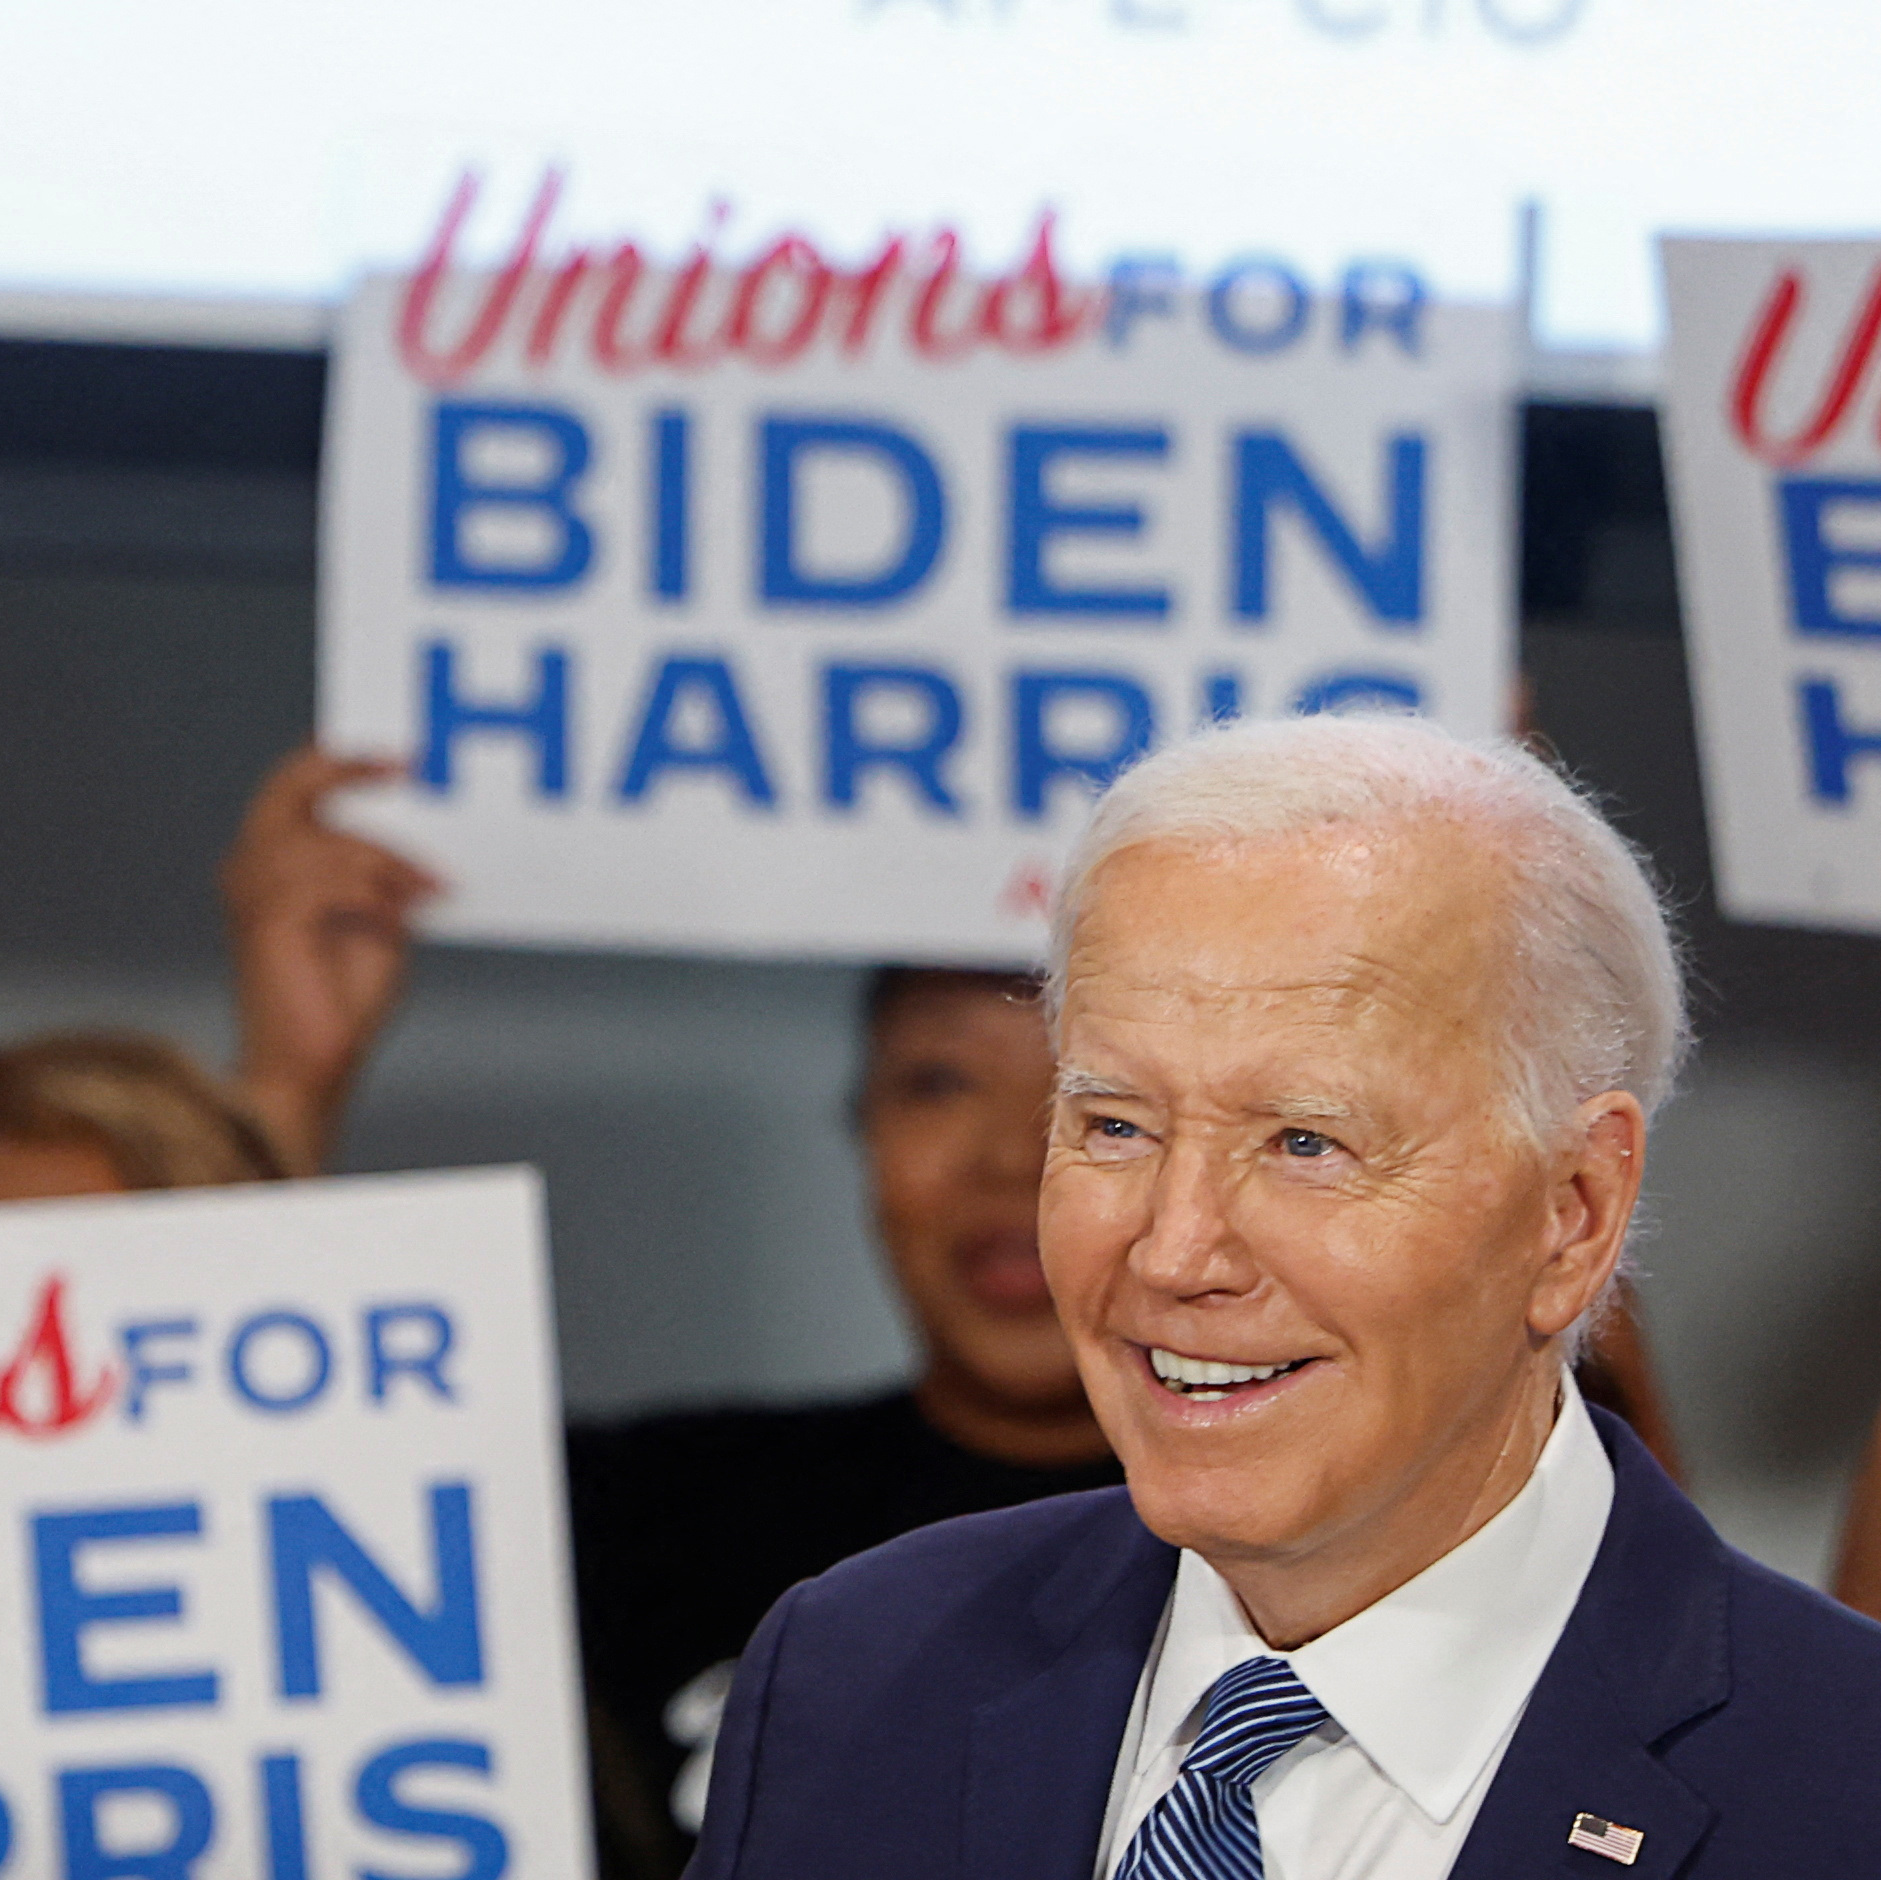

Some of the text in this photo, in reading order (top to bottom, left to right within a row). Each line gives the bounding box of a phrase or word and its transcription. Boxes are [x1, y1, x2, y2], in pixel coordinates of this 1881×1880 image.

[395, 160, 1429, 390] Unions FOR
[420, 395, 1434, 632] BIDEN
[120, 1298, 460, 1422] FOR
